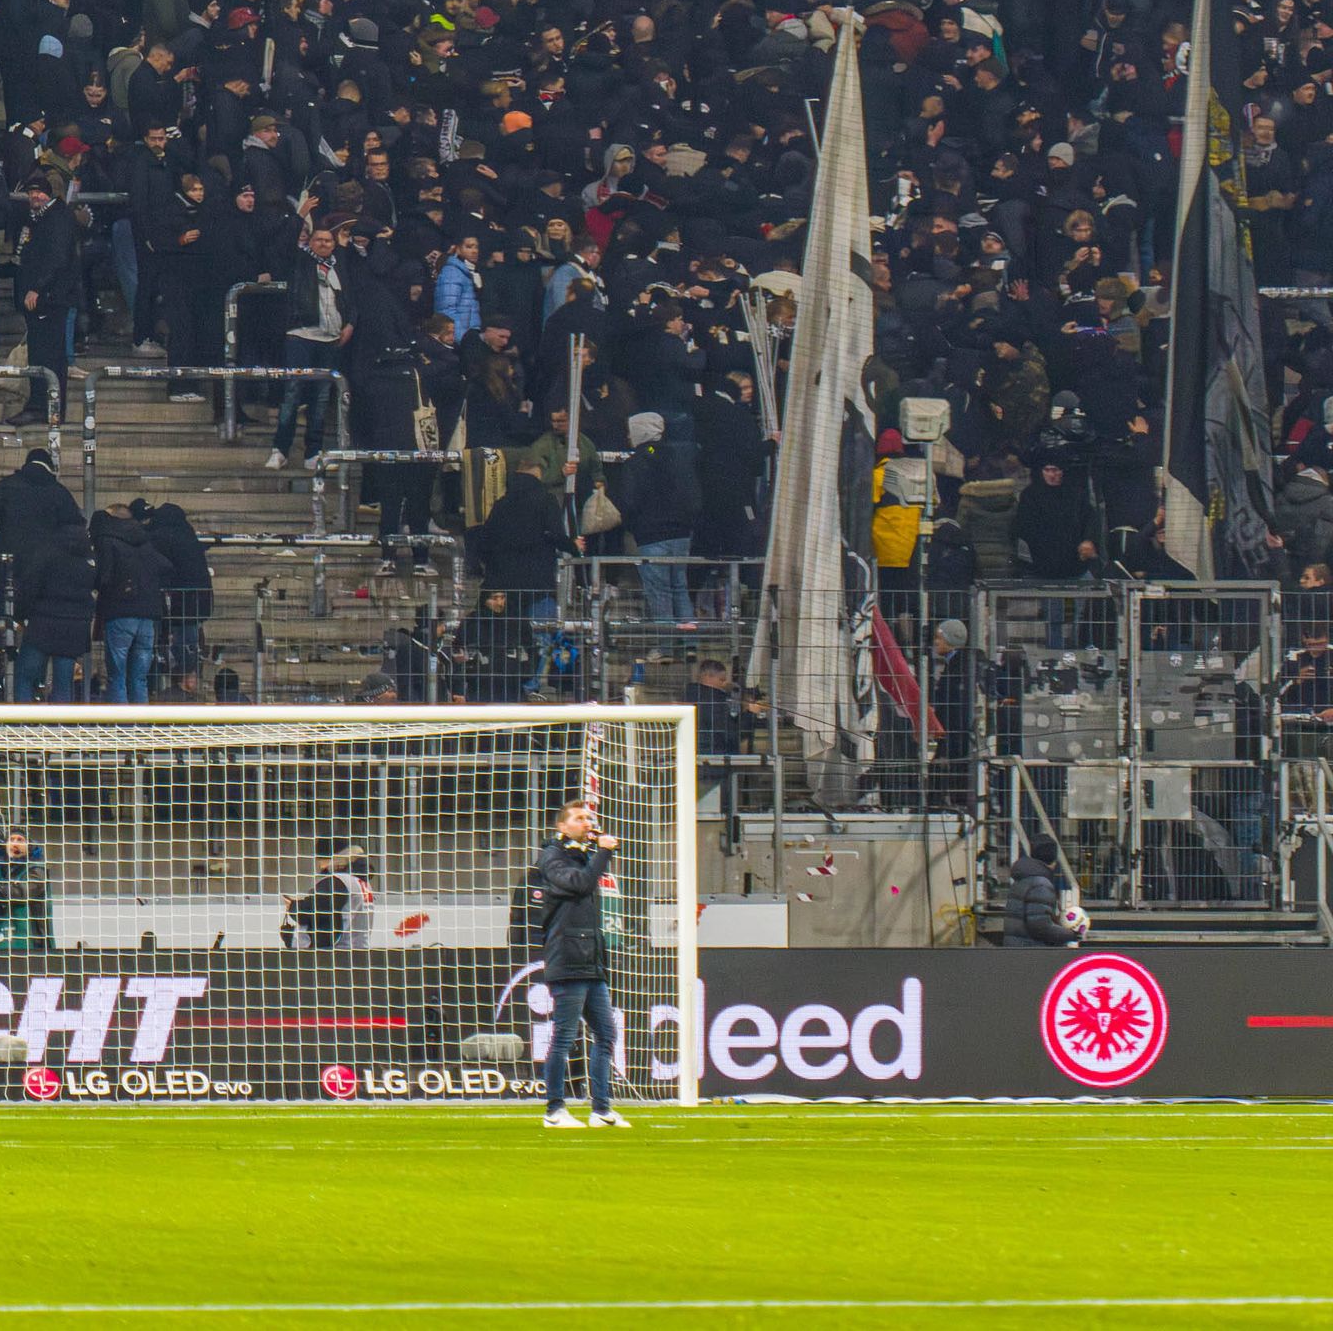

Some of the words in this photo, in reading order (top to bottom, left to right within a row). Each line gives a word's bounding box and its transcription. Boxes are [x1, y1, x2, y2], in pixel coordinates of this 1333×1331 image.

[65, 1070, 110, 1096] LG
[121, 1070, 210, 1096] OLED
[214, 1081, 252, 1096] evo
[364, 1069, 408, 1095] LG
[418, 1069, 507, 1095] OLED
